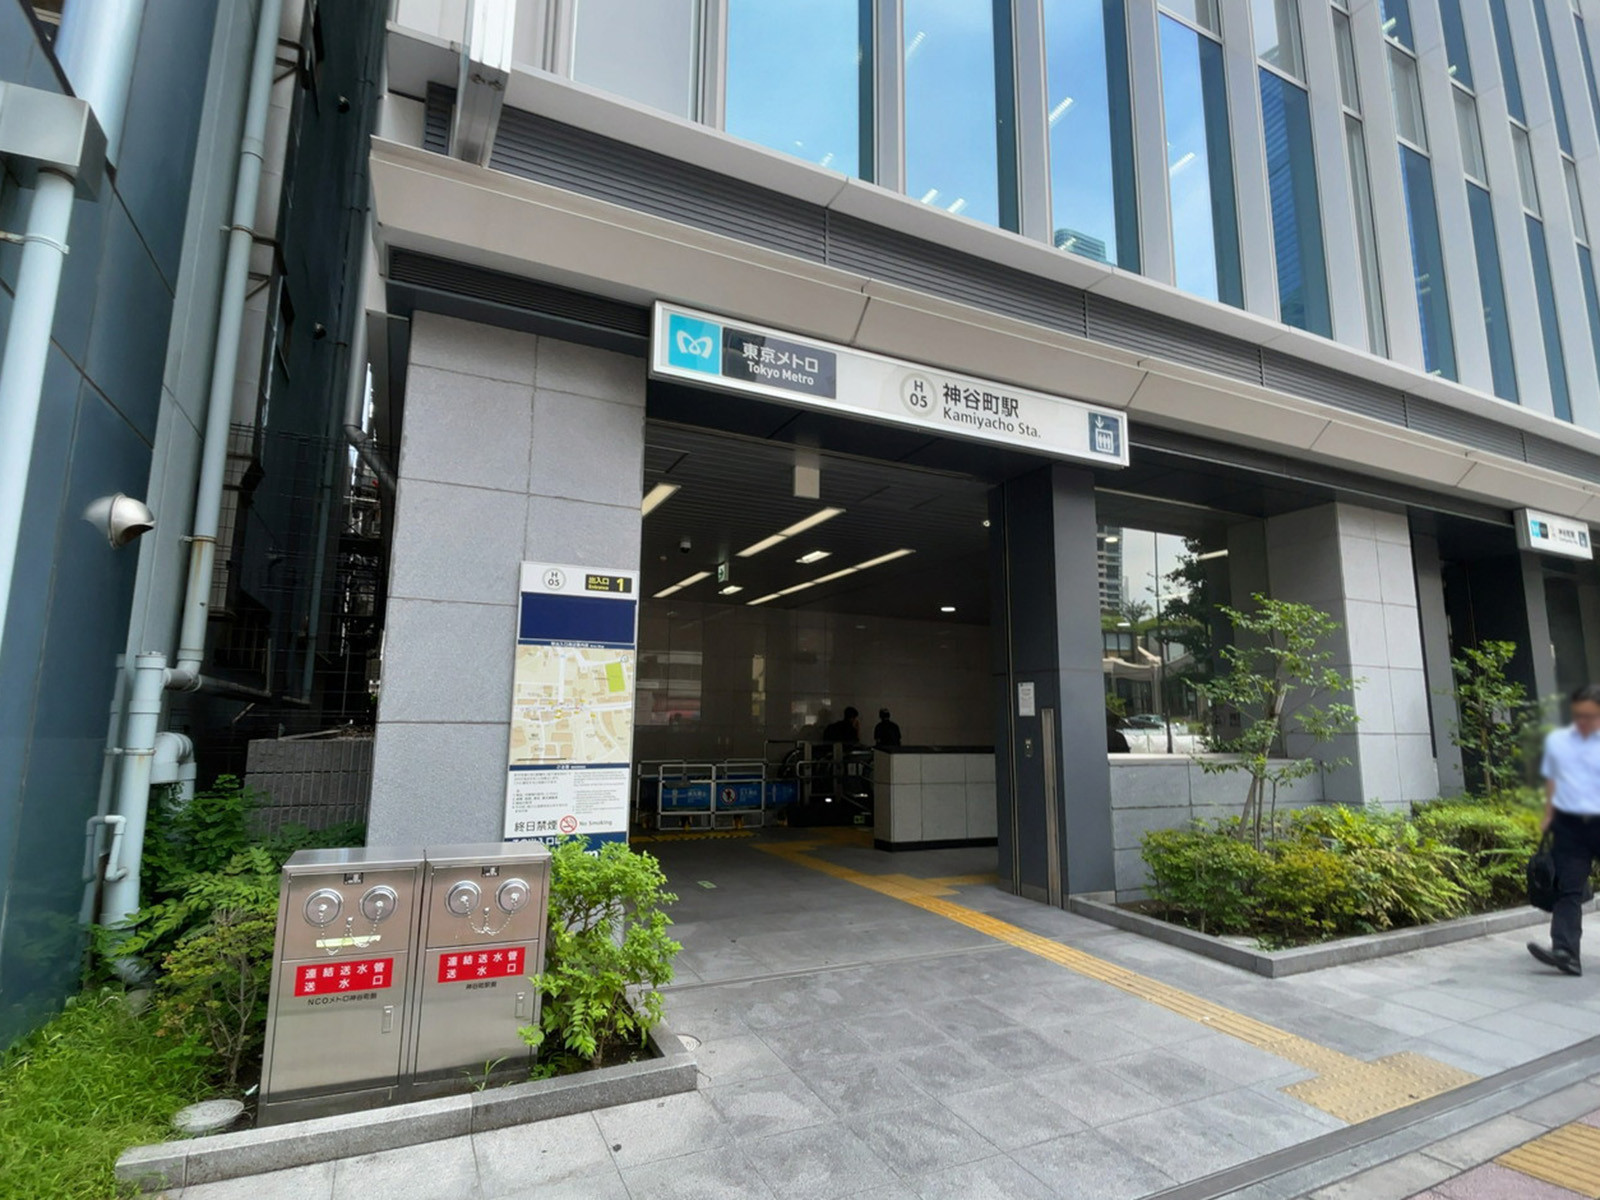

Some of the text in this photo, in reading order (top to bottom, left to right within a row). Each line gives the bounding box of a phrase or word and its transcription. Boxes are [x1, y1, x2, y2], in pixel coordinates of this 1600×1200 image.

[742, 342, 819, 373] 東京メトロ
[747, 360, 814, 386] Tokyo Metro
[914, 380, 923, 393] H
[909, 392, 928, 409] 05
[942, 382, 1019, 418] 神谷町駅
[943, 406, 1042, 438] Kamiyacho Sta.
[548, 578, 560, 587] 05
[616, 577, 624, 592] 1
[514, 820, 557, 832] 終日禁煙
[589, 819, 613, 828] Smoking
[447, 950, 518, 967] 連結送水管
[305, 962, 385, 979] 連結送水管
[446, 963, 517, 979] 送水口
[304, 975, 383, 992] 送水口
